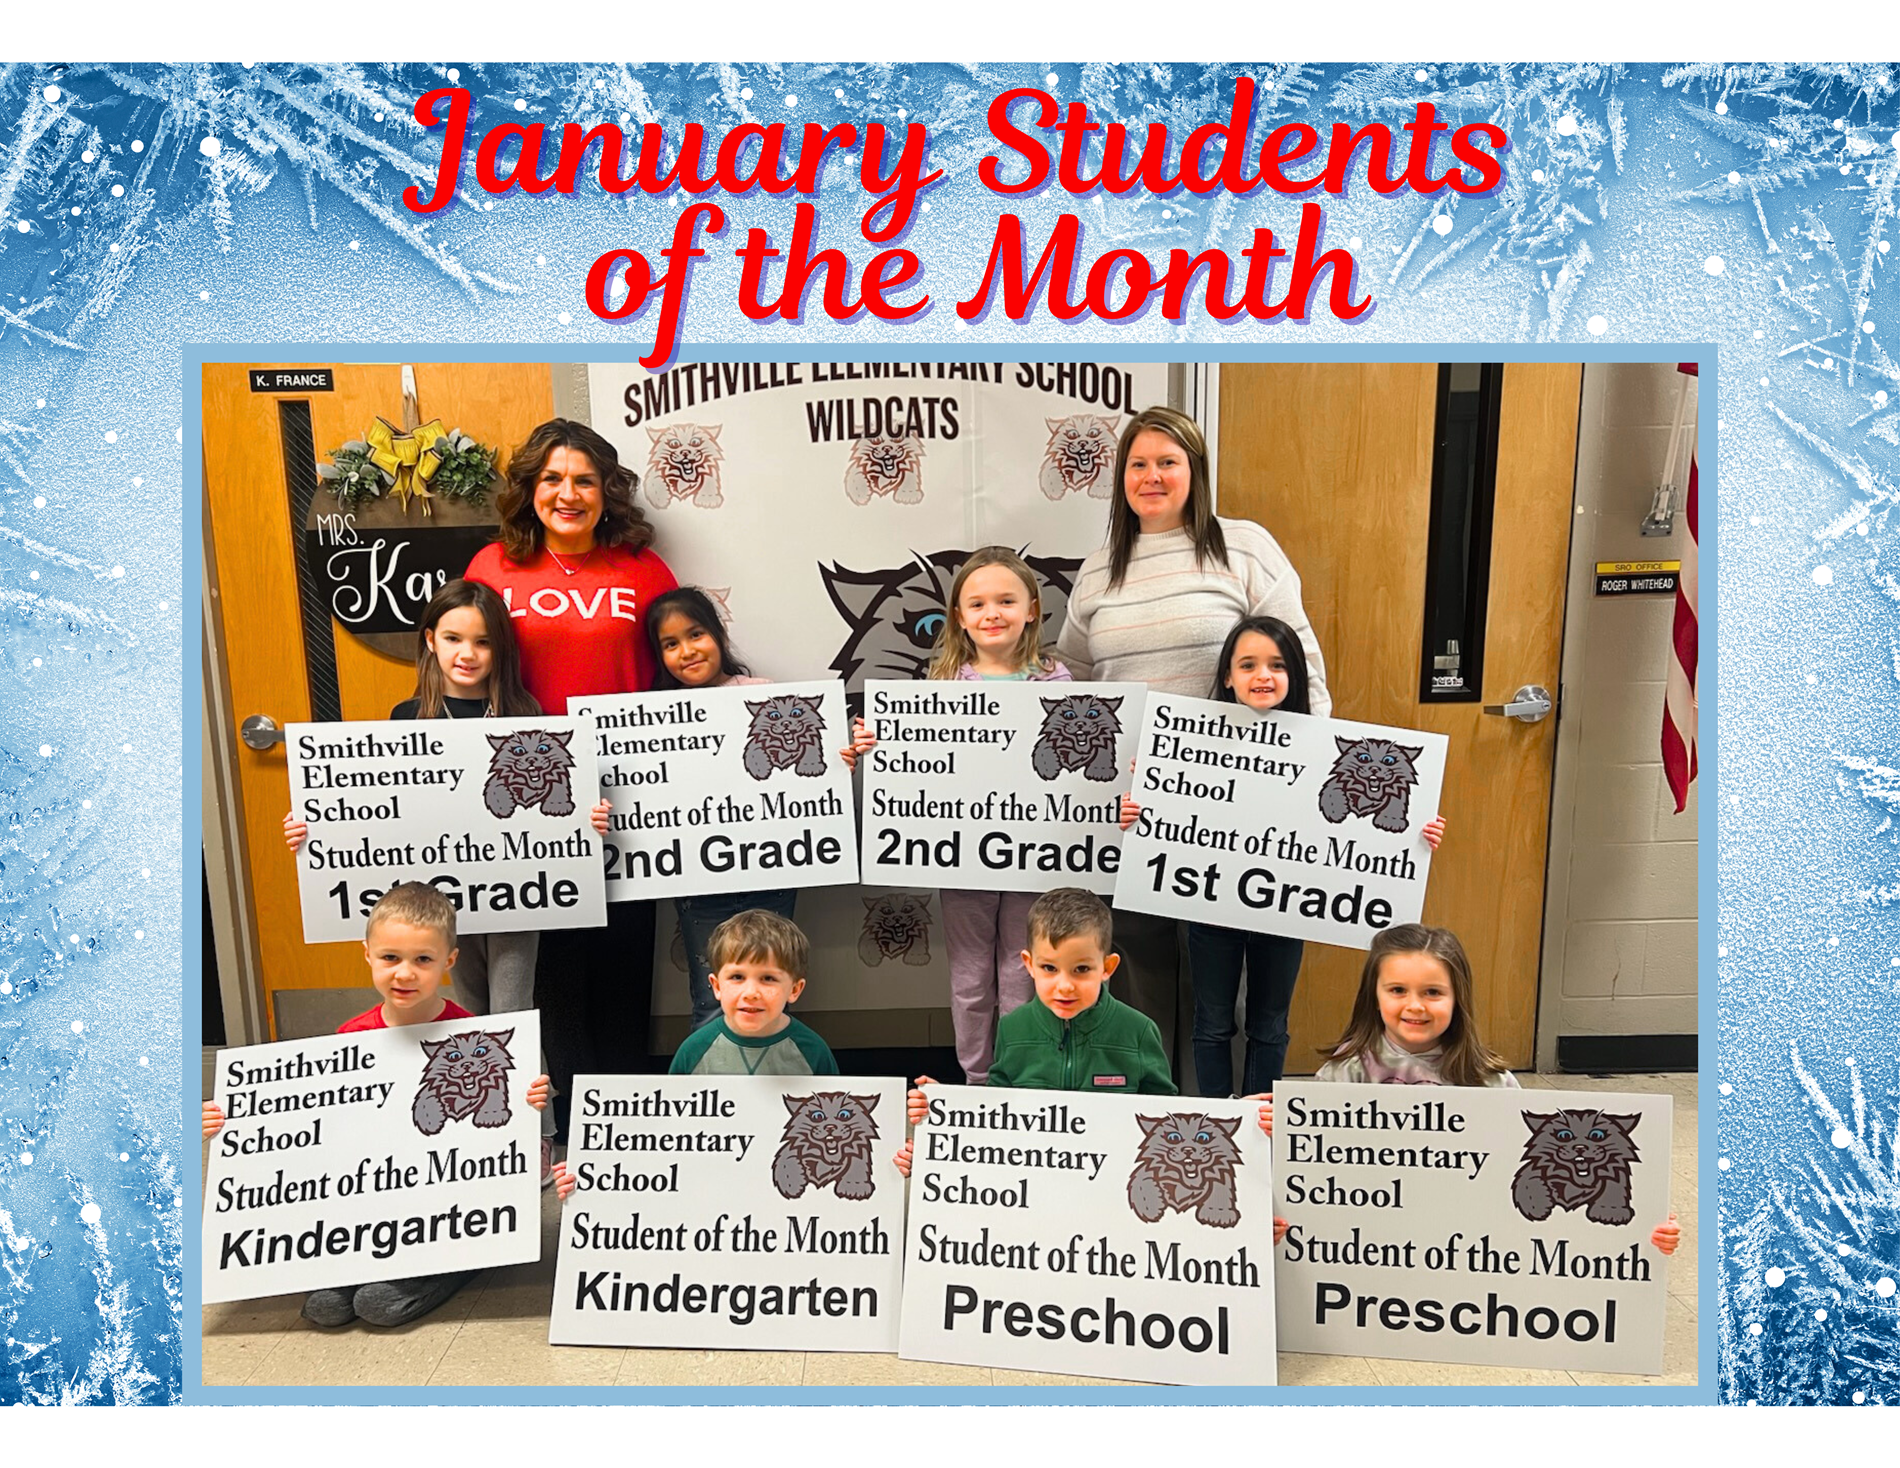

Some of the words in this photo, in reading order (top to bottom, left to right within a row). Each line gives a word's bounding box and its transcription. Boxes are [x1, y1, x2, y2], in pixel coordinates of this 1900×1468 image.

[256, 375, 270, 387] K.
[276, 374, 327, 387] FRANCE
[1015, 363, 1139, 416] SCHOOL
[806, 396, 960, 443] WILDCATS
[317, 514, 364, 546] MRS.
[1601, 580, 1628, 591] ROGER
[1631, 578, 1674, 590] WHITEHEAD
[1615, 564, 1632, 572] SRO
[1636, 563, 1663, 571] OFFICE
[503, 587, 636, 622] LOVE
[873, 691, 1000, 716] Smithville
[299, 732, 444, 759] Smithville
[596, 734, 726, 756] lementary
[875, 719, 1017, 751] Elementary
[1153, 705, 1292, 748] Smithville
[302, 765, 464, 791] Elementary
[600, 762, 669, 788] chool
[873, 750, 956, 774] School
[1149, 733, 1306, 786] Elementary
[1143, 766, 1236, 803] School
[305, 796, 401, 822] School
[607, 802, 681, 832] tudent
[687, 796, 714, 826] of
[716, 797, 755, 823] the
[760, 788, 843, 820] Month
[872, 788, 964, 819] Student
[970, 791, 997, 820] of
[999, 793, 1037, 822] the
[309, 838, 414, 870] Student
[422, 834, 450, 864] of
[455, 833, 496, 862] the
[501, 828, 593, 861] Month
[604, 839, 682, 881] 2nd
[700, 829, 841, 873] Grade
[876, 828, 961, 868] 2nd
[979, 832, 1121, 874] Grade
[1136, 807, 1239, 852] Student
[1244, 827, 1276, 857] of
[1277, 831, 1318, 864] the
[1323, 836, 1416, 880] Month
[329, 879, 400, 919] 1s
[1147, 852, 1221, 902] 1st
[1238, 867, 1392, 929] Grade
[226, 1045, 376, 1087] Smithville
[224, 1079, 395, 1120] Elementary
[582, 1089, 736, 1118] Smithville
[927, 1098, 1086, 1135] Smithville
[1287, 1097, 1466, 1133] Smithville
[221, 1118, 322, 1158] School
[579, 1123, 755, 1162] Elementary
[925, 1132, 1107, 1181] Elementary
[1286, 1133, 1490, 1180] Elementary
[215, 1169, 331, 1213] Student
[337, 1158, 371, 1197] of
[372, 1155, 419, 1192] the
[425, 1140, 528, 1185] Month
[576, 1162, 679, 1192] School
[923, 1173, 1029, 1208] School
[1286, 1174, 1404, 1209] School
[219, 1204, 517, 1270] Kindergarten
[571, 1212, 688, 1251] Student
[694, 1214, 729, 1251] of
[731, 1214, 777, 1253] the
[784, 1216, 890, 1255] Month
[1284, 1224, 1416, 1268] Student
[1424, 1233, 1464, 1272] of
[1466, 1234, 1520, 1275] the
[1529, 1238, 1652, 1283] Month
[918, 1223, 1040, 1271] Student
[1048, 1234, 1083, 1274] of
[1086, 1236, 1136, 1278] the
[1144, 1239, 1261, 1288] Month
[575, 1271, 878, 1326] Kindergarten
[1315, 1281, 1616, 1343] Preschool
[944, 1284, 1229, 1355] Preschool
